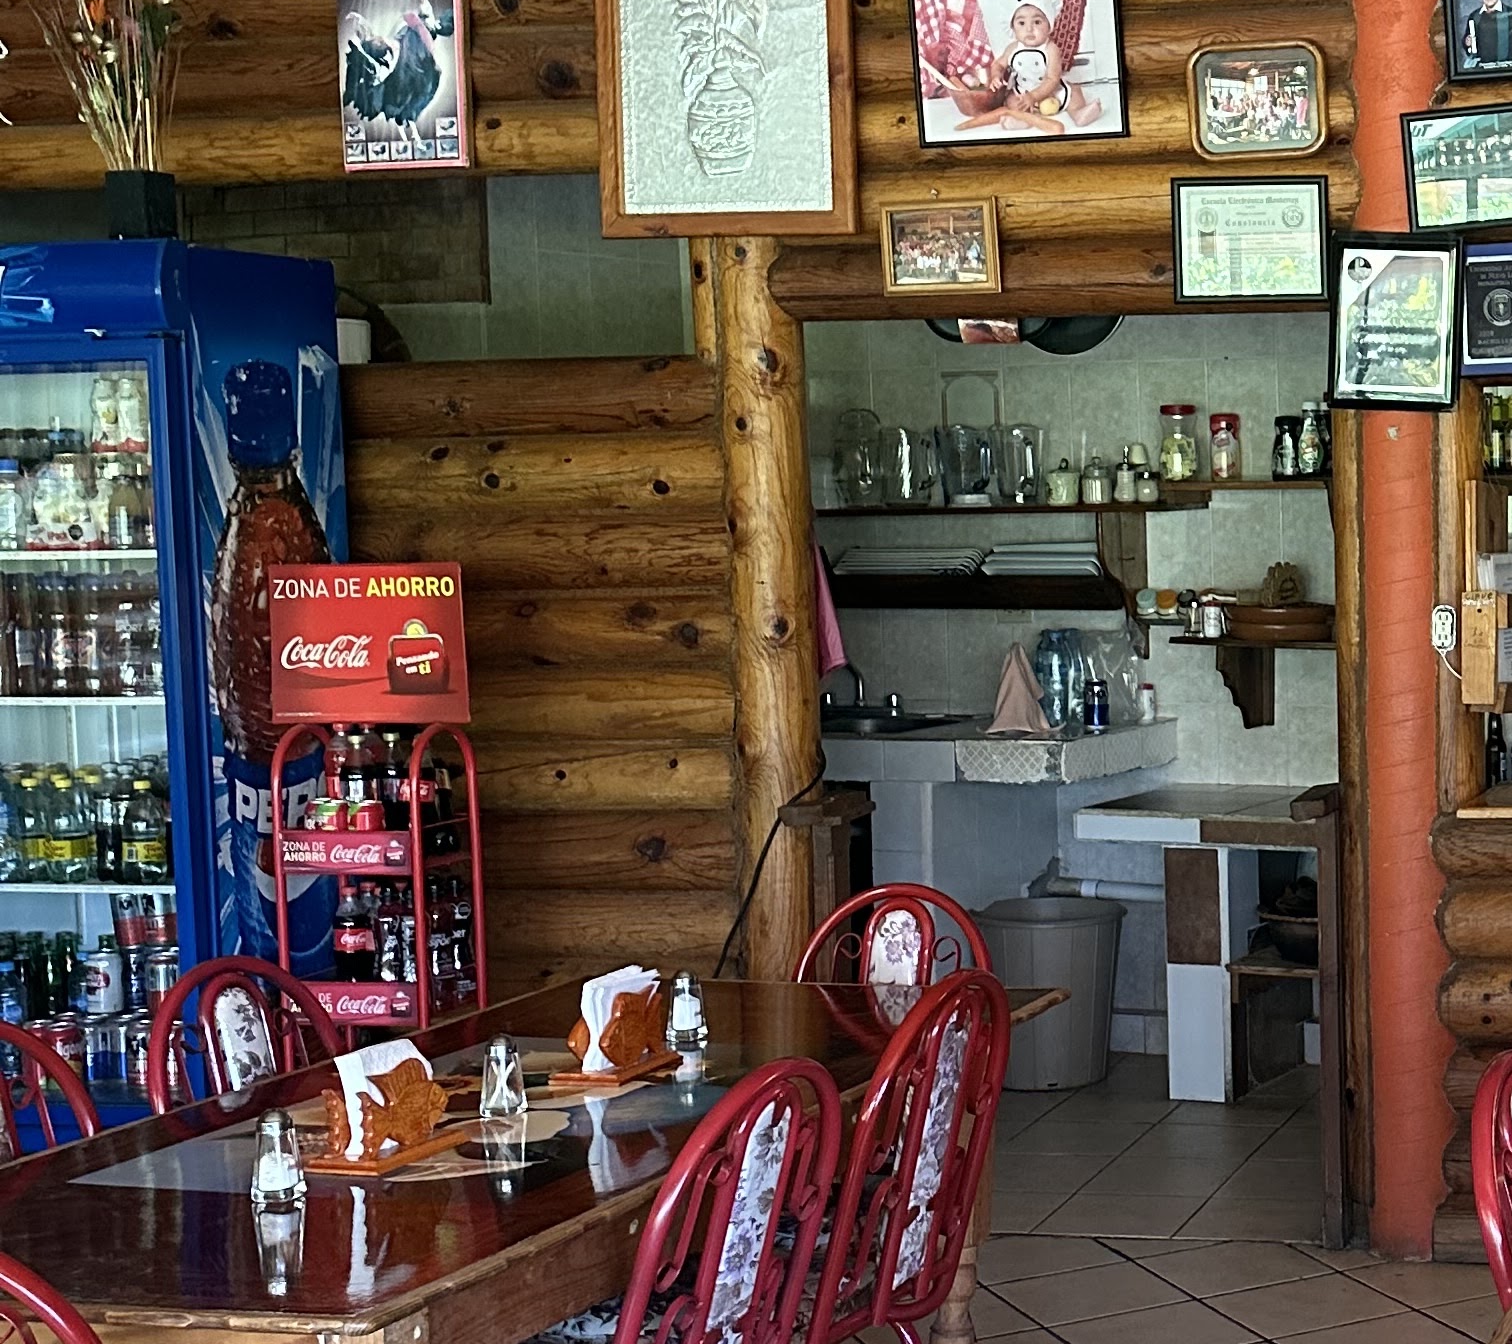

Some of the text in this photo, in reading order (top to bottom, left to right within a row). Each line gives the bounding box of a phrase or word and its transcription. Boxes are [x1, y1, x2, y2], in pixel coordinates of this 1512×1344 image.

[273, 576, 455, 599] ZONA DE AHORRO
[280, 635, 372, 669] Coca-Cola
[418, 661, 431, 675] ti
[283, 841, 326, 851] ZONA DE
[330, 844, 383, 864] Coca-Cola
[283, 851, 327, 863] AHORRO
[318, 993, 332, 1002] DE
[336, 995, 388, 1015] Coca-Cola
